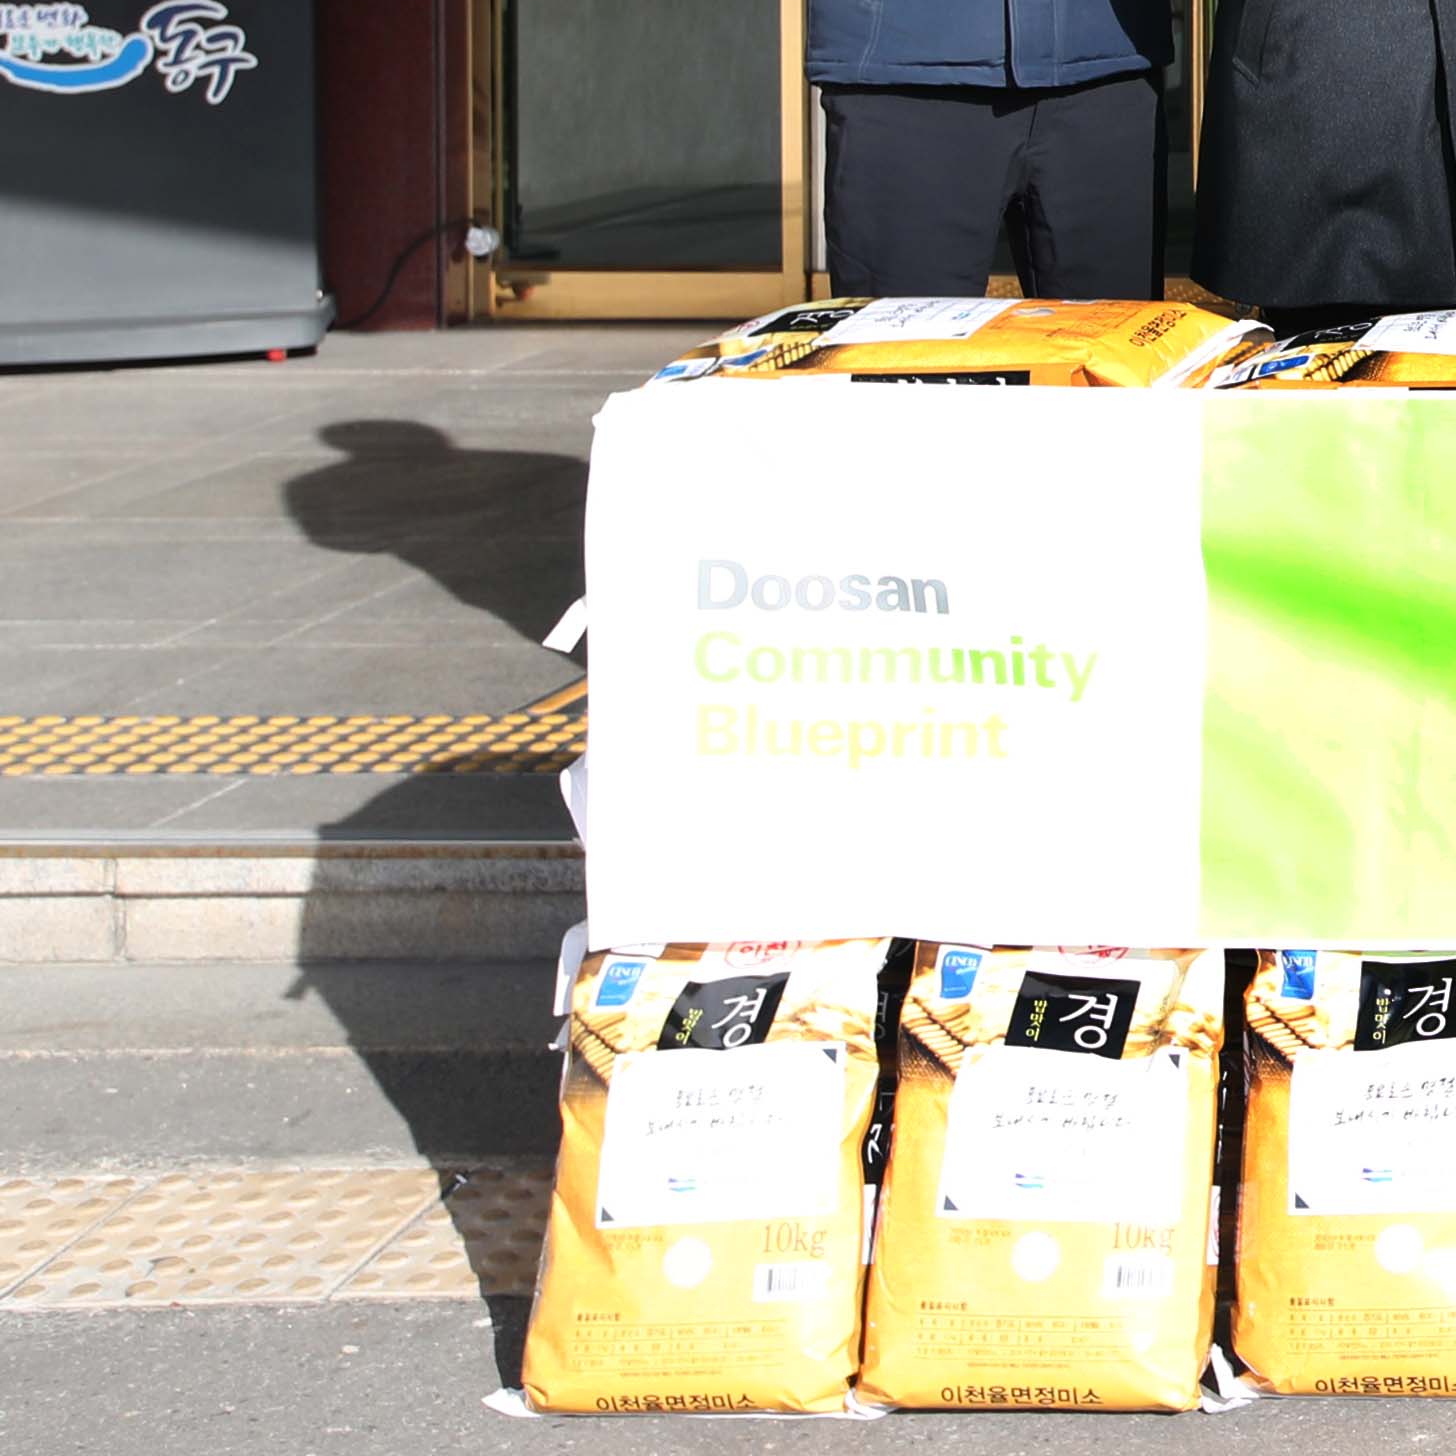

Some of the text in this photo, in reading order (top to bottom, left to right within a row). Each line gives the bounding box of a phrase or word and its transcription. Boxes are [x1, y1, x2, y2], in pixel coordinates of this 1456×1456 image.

[144, 0, 257, 102] 동구
[695, 558, 950, 615] Doosan
[693, 630, 1101, 704] Community
[694, 704, 1010, 771] Blueprint
[711, 987, 766, 1048] 경
[1059, 993, 1116, 1049] 경
[1404, 977, 1453, 1037] 경
[762, 1222, 827, 1257] 10kg
[1112, 1222, 1176, 1254] 10kg
[595, 1393, 758, 1412] 이천율면정미소
[941, 1385, 1103, 1406] 이천율면정미소
